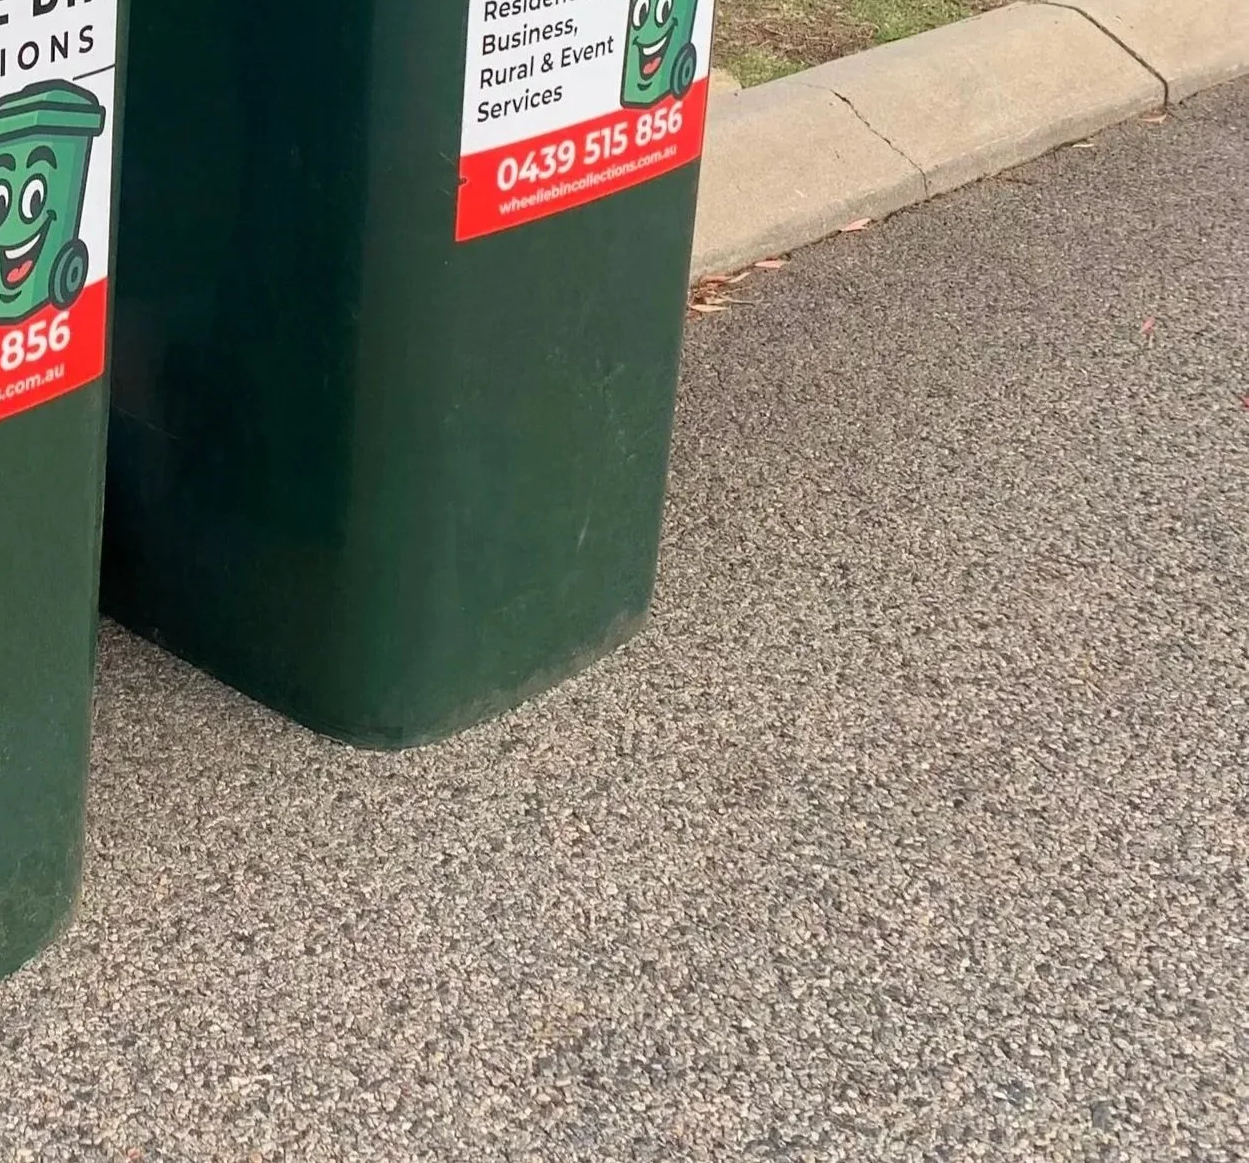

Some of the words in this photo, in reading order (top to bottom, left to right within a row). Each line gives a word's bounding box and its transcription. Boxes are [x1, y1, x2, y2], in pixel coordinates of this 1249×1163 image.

[480, 56, 535, 89] Rural
[541, 53, 554, 73] &
[560, 36, 614, 68] Event
[481, 16, 578, 56] Business,
[477, 85, 563, 123] Services
[497, 140, 576, 191] 0439
[583, 122, 628, 165] 515
[635, 102, 683, 148] 856
[499, 145, 677, 215] wheeliebincollections.com.au
[0, 311, 70, 371] 856
